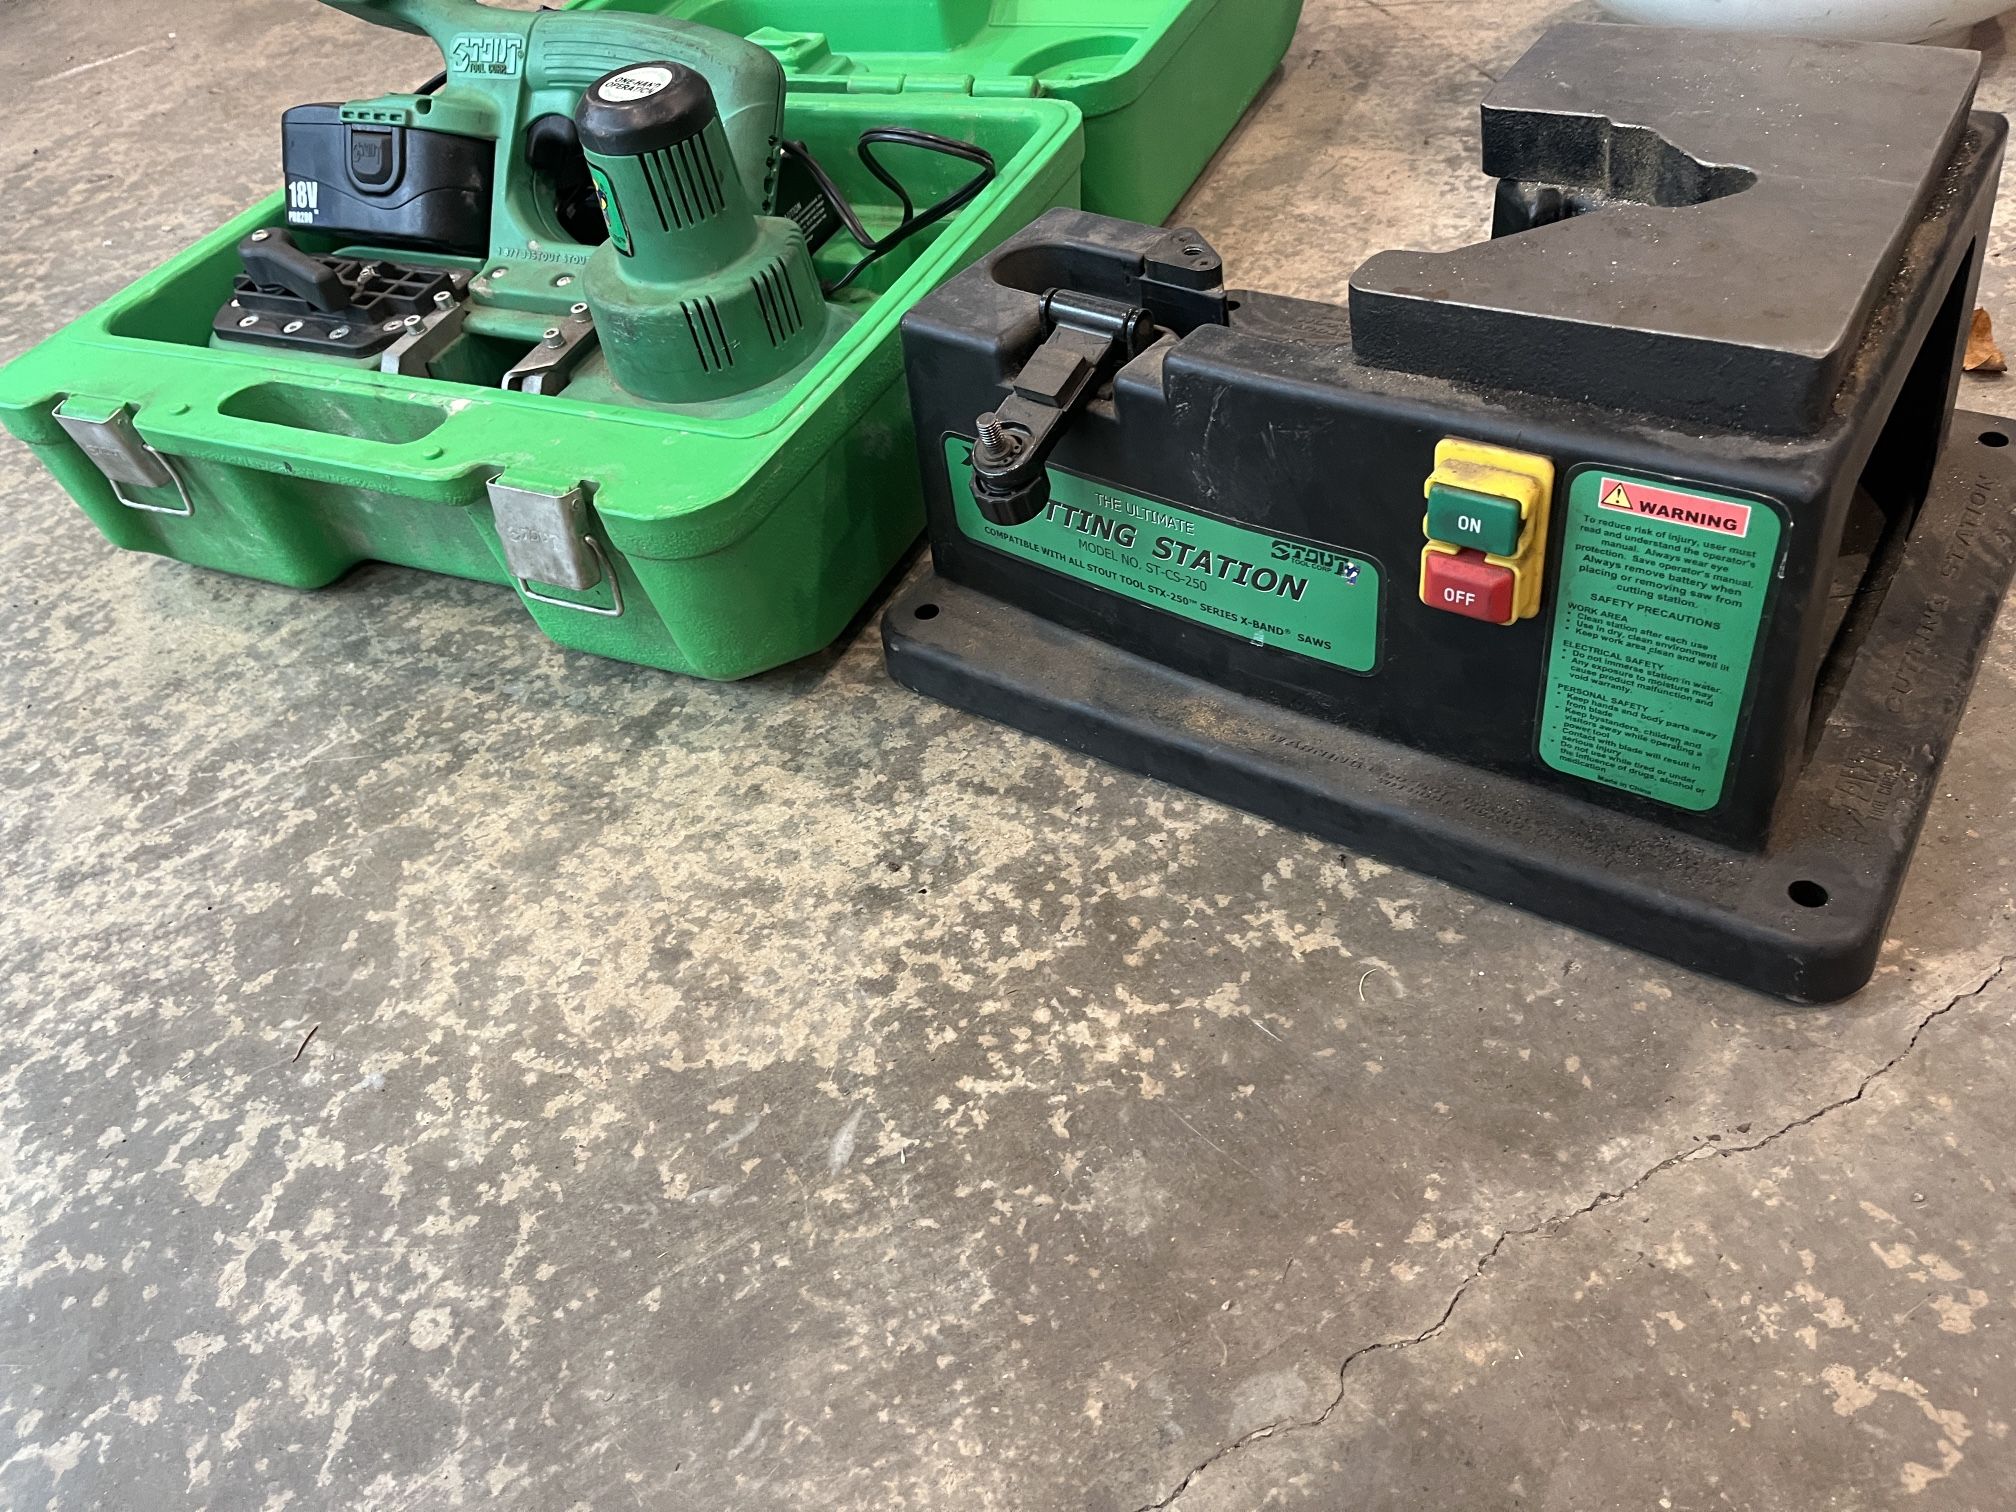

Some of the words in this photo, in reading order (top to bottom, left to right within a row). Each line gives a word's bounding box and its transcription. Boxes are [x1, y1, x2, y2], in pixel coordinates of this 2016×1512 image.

[288, 181, 318, 209] 18V
[1095, 492, 1122, 512] THE
[1126, 502, 1195, 536] ULTIMATE
[1457, 515, 1482, 534] ON
[1639, 500, 1738, 531] WARNING
[1046, 500, 1138, 550] TTING
[1152, 536, 1310, 602] STATION
[1580, 525, 1601, 535] read
[1603, 530, 1622, 539] and
[1624, 534, 1681, 552] understand
[1583, 514, 1596, 523] To
[1598, 519, 1632, 531] reduce
[1634, 525, 1653, 536] risk
[1703, 541, 1727, 551] user
[1729, 547, 1756, 558] must
[1078, 538, 1118, 562] MODEL
[1121, 553, 1142, 570] NO.
[1146, 562, 1207, 592] ST-CS-250
[1270, 539, 1350, 576] STOUT
[1601, 539, 1639, 552] manual.
[1644, 548, 1681, 562] Always
[1683, 557, 1709, 567] wear
[1710, 563, 1729, 572] eye
[1632, 554, 1656, 566] Save
[1712, 574, 1753, 588] manual.
[984, 526, 1040, 552] COMPATIBLE
[1041, 546, 1066, 562] WITH
[1068, 556, 1085, 569] ALL
[1087, 563, 1117, 580] STOUT
[1120, 574, 1145, 590] TOOL
[1200, 603, 1238, 622] SERIES
[1297, 633, 1332, 650] SAWS
[1578, 564, 1618, 581] placing
[1620, 574, 1633, 582] or
[1634, 578, 1687, 596] removing
[1689, 590, 1712, 600] saw
[1715, 594, 1742, 608] from
[1582, 554, 1621, 569] Always
[1624, 564, 1665, 579] remove
[1668, 572, 1708, 590] battery
[1710, 584, 1742, 596] when
[1443, 587, 1476, 606] OFF
[1567, 602, 1598, 615] WORK
[1599, 610, 1628, 623] AREA
[1590, 593, 1635, 609] SAFETY
[1636, 604, 1720, 630] PRECAUTIONS
[1616, 584, 1654, 600] cutting
[1657, 594, 1698, 608] station.
[1575, 627, 1599, 639] Keep
[1600, 635, 1624, 645] work
[1625, 641, 1646, 651] area
[1648, 647, 1674, 658] clean
[1676, 654, 1696, 663] and
[1697, 659, 1718, 669] well
[1576, 619, 1594, 630] Use
[1627, 633, 1653, 645] clean
[1655, 641, 1717, 661] environment
[1577, 612, 1604, 625] Clean
[1606, 620, 1638, 633] station
[1639, 629, 1663, 639] after
[1664, 635, 1688, 645] each
[1690, 641, 1709, 650] use
[1563, 639, 1622, 661] ELECTRICAL
[1625, 655, 1664, 671] SAFETY
[1572, 649, 1585, 658] Do
[1586, 655, 1602, 663] not
[1604, 657, 1644, 674] immerse
[1646, 669, 1679, 683] station
[1569, 672, 1589, 682] void
[1570, 665, 1598, 676] cause
[1598, 673, 1635, 687] product
[1636, 683, 1693, 702] malfunction
[1694, 698, 1714, 707] and
[1571, 657, 1589, 668] Any
[1591, 663, 1634, 679] exposure
[1635, 671, 1646, 682] to
[1647, 678, 1690, 693] moisture
[1692, 689, 1713, 699] may
[1557, 683, 1608, 702] PERSONAL
[1611, 697, 1649, 712] SAFETY
[1566, 699, 1586, 711] from
[1588, 706, 1613, 718] blade
[1566, 692, 1590, 705] Keep
[1591, 699, 1619, 712] hands
[1621, 708, 1639, 717] and
[1640, 713, 1665, 725] body
[1665, 721, 1690, 731] parts
[1692, 728, 1718, 739] away
[1562, 722, 1592, 735] power
[1592, 729, 1610, 739] tool
[1564, 706, 1587, 719] Keep
[1683, 740, 1702, 749] and
[1598, 724, 1622, 736] away
[1624, 731, 1648, 742] while
[1650, 738, 1695, 756] operating
[1560, 740, 1573, 749] Do
[1574, 745, 1589, 754] not
[1590, 750, 1607, 759] use
[1608, 754, 1632, 766] while
[1634, 762, 1655, 772] tired
[1669, 772, 1696, 784] under
[1562, 726, 1596, 742] Contact
[1597, 738, 1617, 748] with
[1618, 743, 1643, 755] blade
[1645, 751, 1661, 760] will
[1663, 756, 1690, 768] result
[1617, 763, 1629, 772] of
[1659, 777, 1694, 790] alcohol
